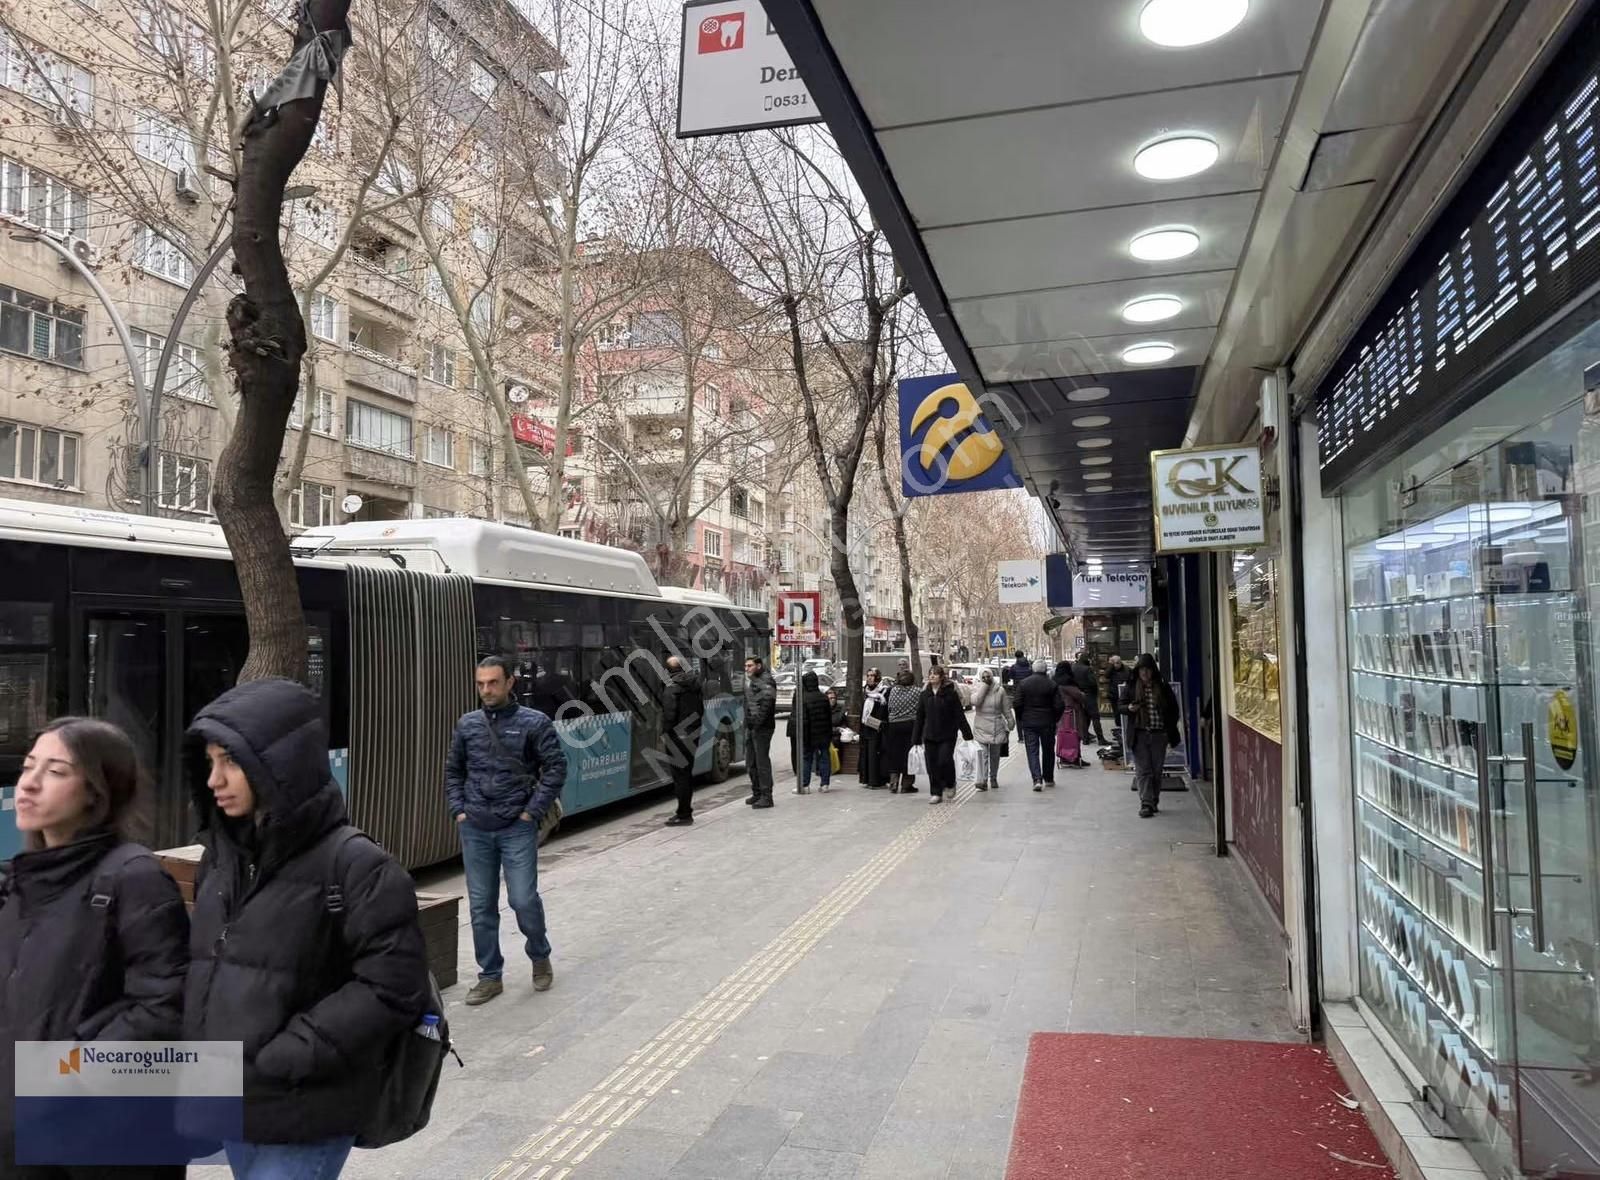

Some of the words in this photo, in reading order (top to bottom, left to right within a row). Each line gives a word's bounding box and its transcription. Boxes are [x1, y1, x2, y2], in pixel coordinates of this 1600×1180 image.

[773, 93, 808, 108] 0531
[1165, 455, 1255, 499] GK
[1080, 573, 1103, 583] Türk
[1105, 573, 1147, 583] Telekom
[789, 602, 808, 627] D
